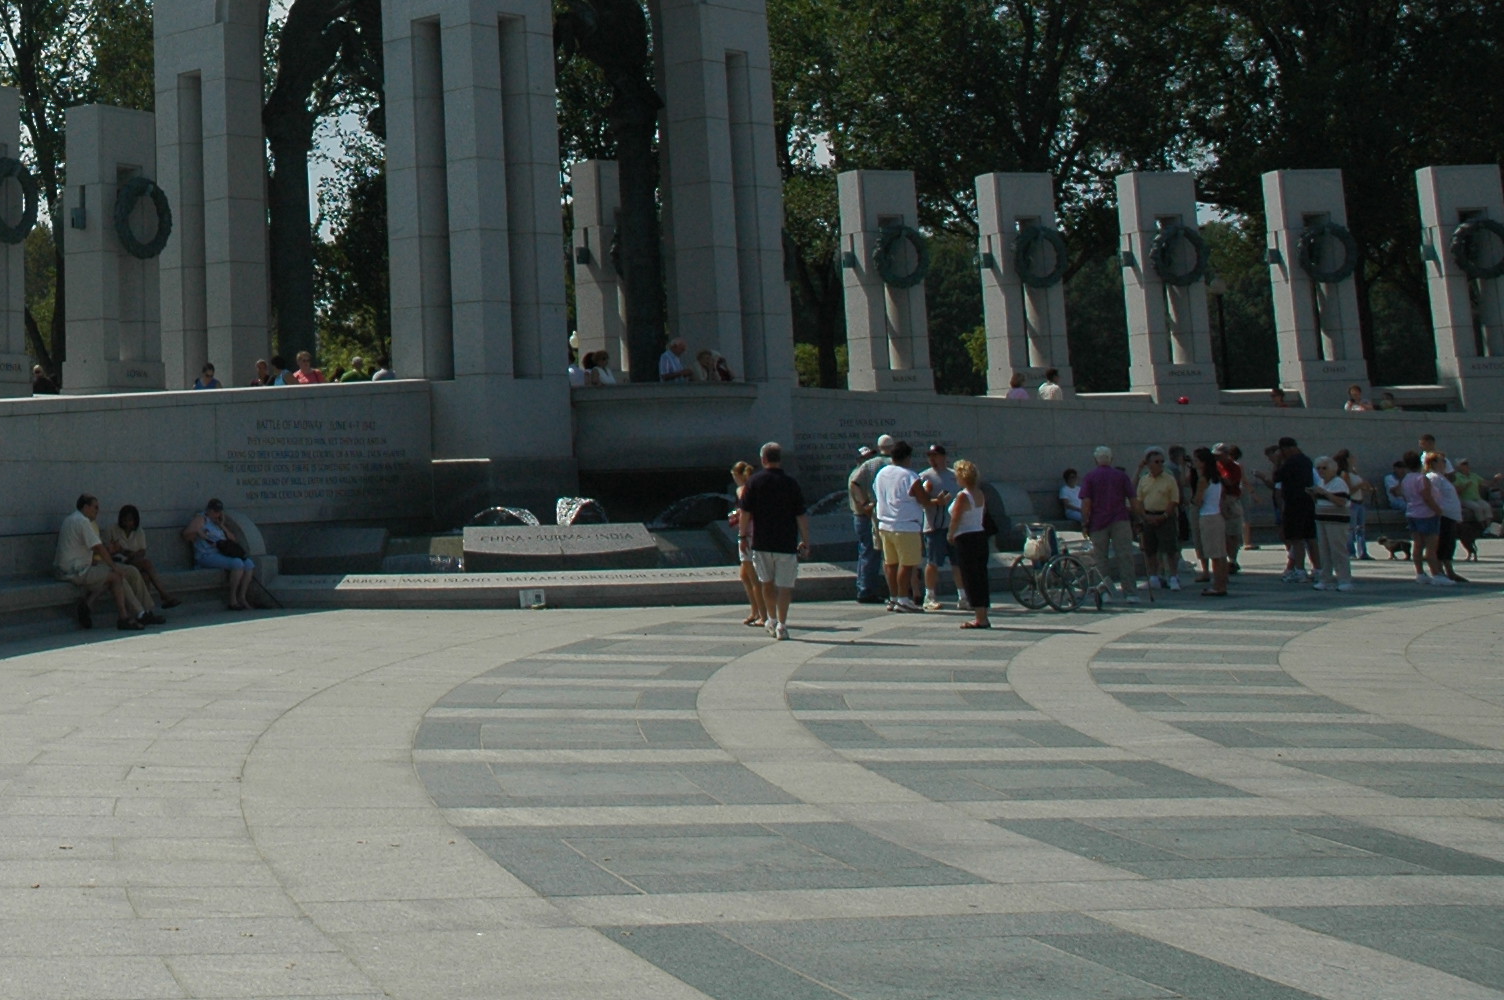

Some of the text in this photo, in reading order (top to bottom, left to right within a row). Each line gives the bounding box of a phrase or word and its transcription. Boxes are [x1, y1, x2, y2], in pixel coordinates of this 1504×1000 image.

[126, 369, 148, 378] IOWA
[256, 420, 280, 430] BATTLE
[282, 420, 291, 429] OF
[293, 420, 322, 430] MIDWAY
